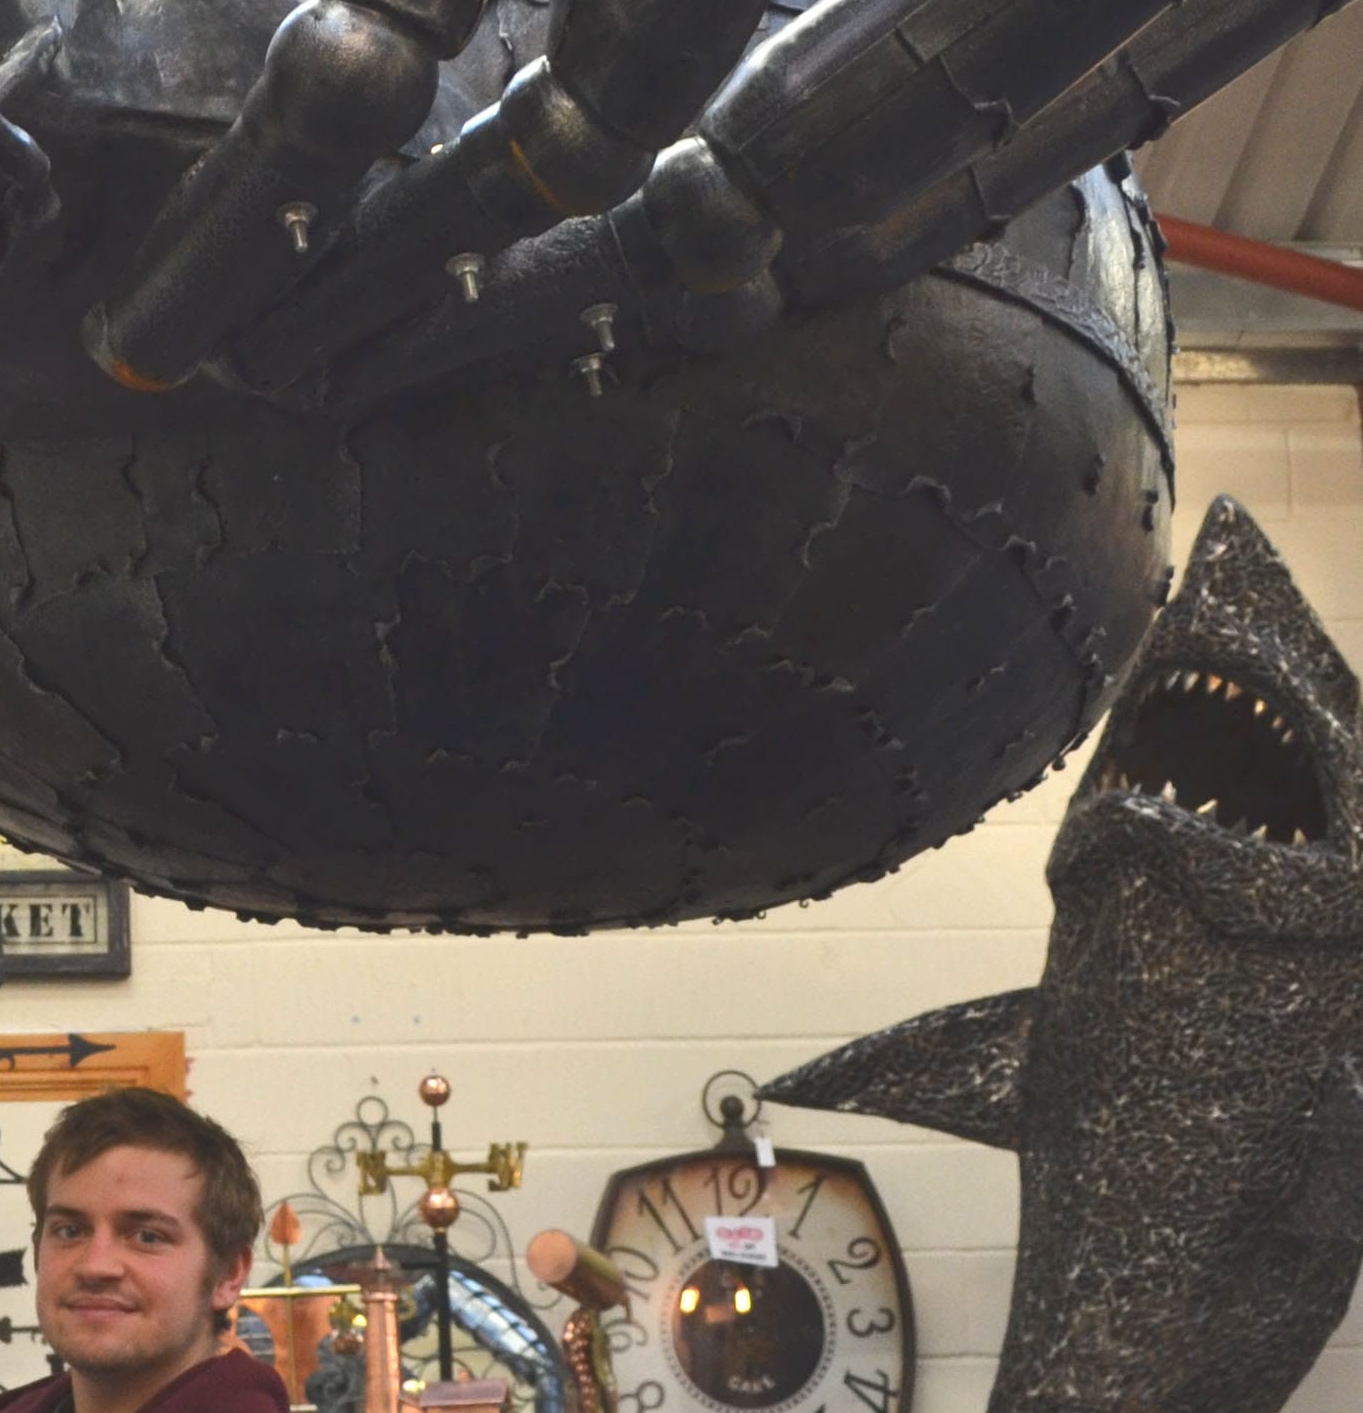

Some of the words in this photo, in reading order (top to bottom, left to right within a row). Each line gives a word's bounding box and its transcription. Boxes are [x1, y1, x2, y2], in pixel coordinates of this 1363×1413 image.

[636, 1176, 703, 1252] 11
[789, 1175, 825, 1239] 1
[827, 1237, 881, 1285] 2
[846, 1307, 896, 1339] 3
